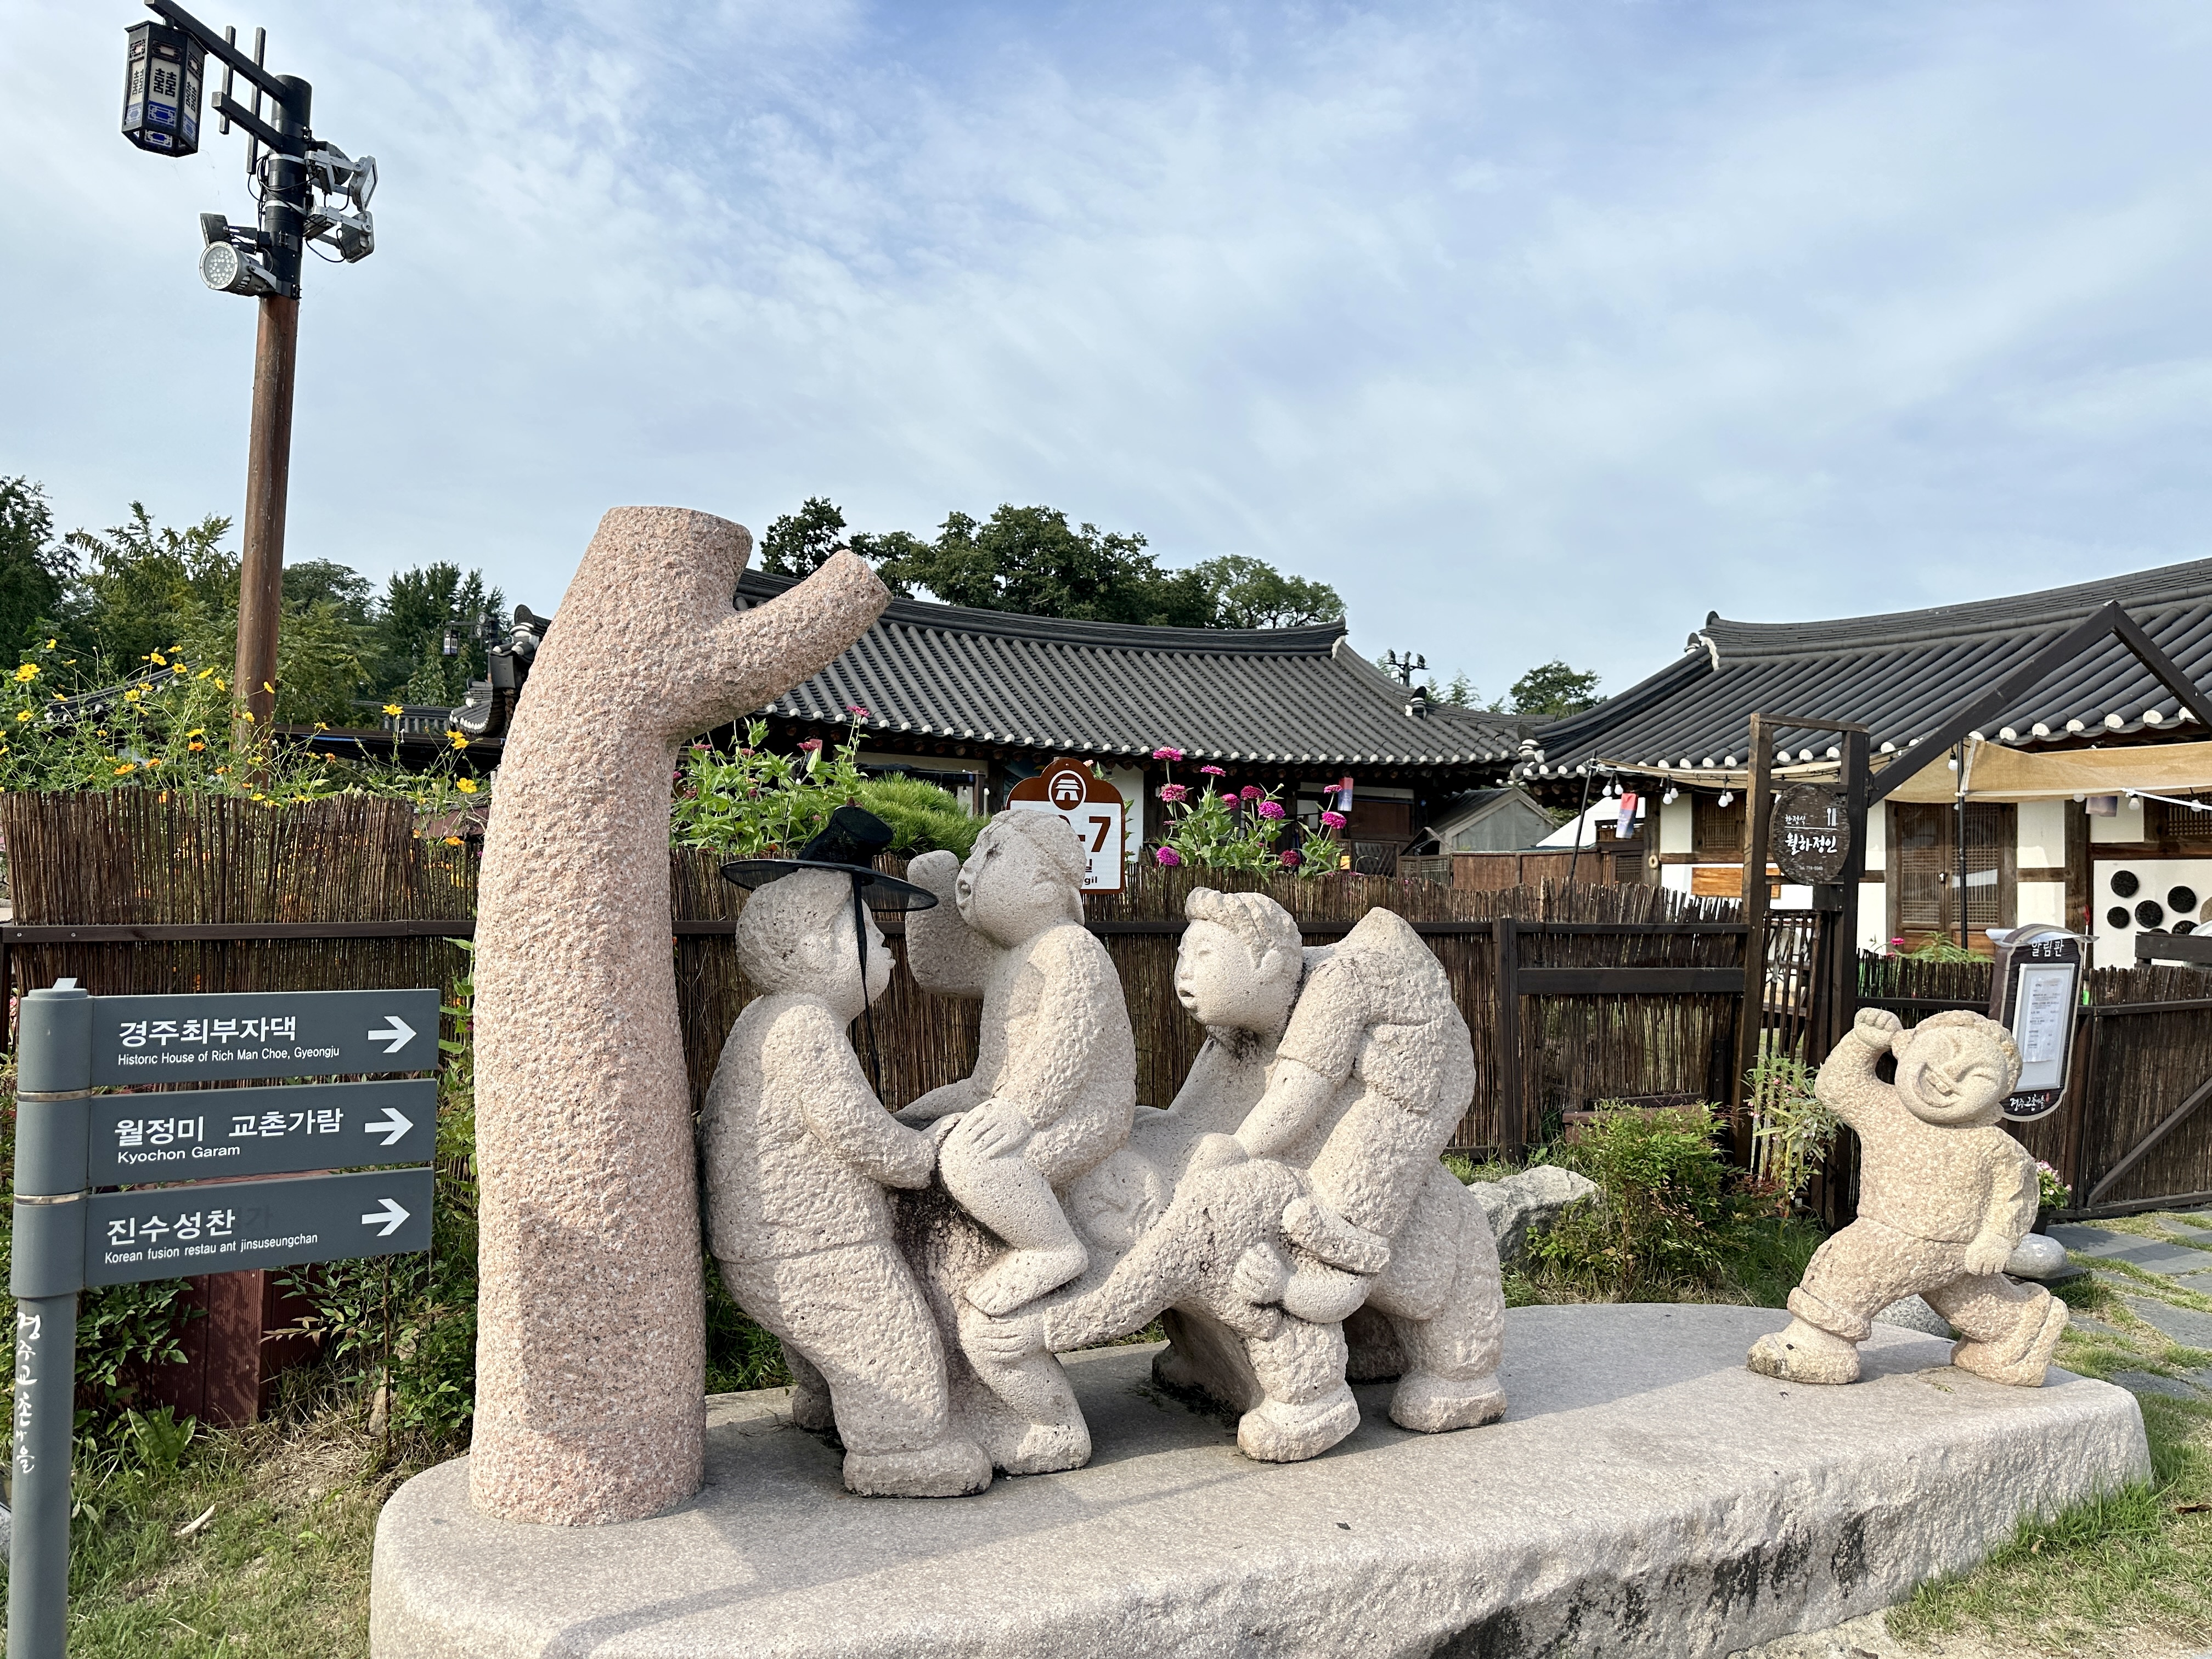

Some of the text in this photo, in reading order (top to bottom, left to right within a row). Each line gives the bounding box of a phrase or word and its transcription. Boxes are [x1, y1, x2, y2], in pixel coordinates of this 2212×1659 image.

[1785, 814, 1806, 825] 한정식
[1785, 832, 1837, 855] 월하정인
[2032, 939, 2064, 957] 알림판
[119, 1016, 296, 1047] 경주최부자댁
[118, 1045, 340, 1065] Historic House of Rich Man Choe, Gyeongju
[114, 1108, 344, 1147] 월정미 교촌가람
[117, 1146, 240, 1165] Kyochon Garam
[106, 1209, 236, 1246] 진수성찬
[105, 1251, 143, 1264] Korean
[148, 1246, 179, 1260] fusion
[240, 1233, 318, 1253] jinsuseungchan
